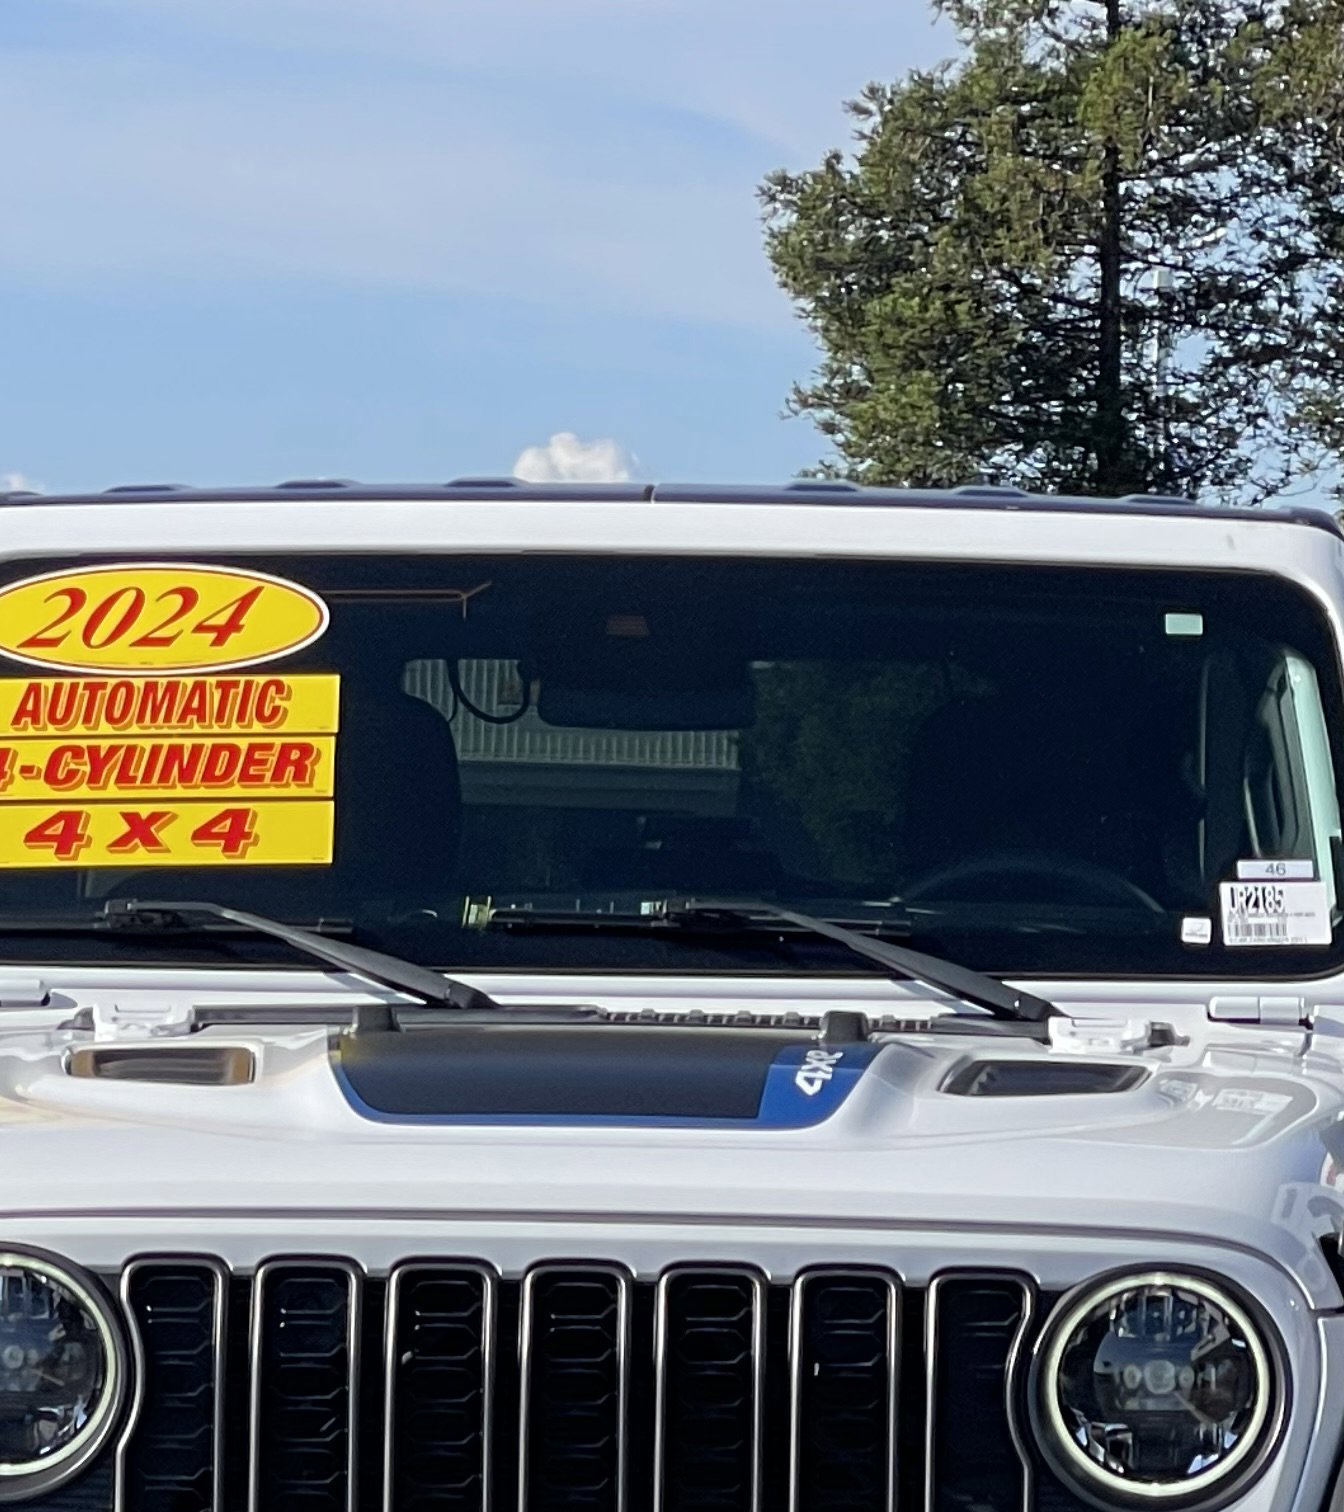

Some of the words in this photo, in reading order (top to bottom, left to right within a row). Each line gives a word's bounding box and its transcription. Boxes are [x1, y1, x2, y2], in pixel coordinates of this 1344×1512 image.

[17, 585, 264, 650] 2024
[10, 679, 291, 732] AUTOMATIC
[1265, 862, 1287, 877] 46
